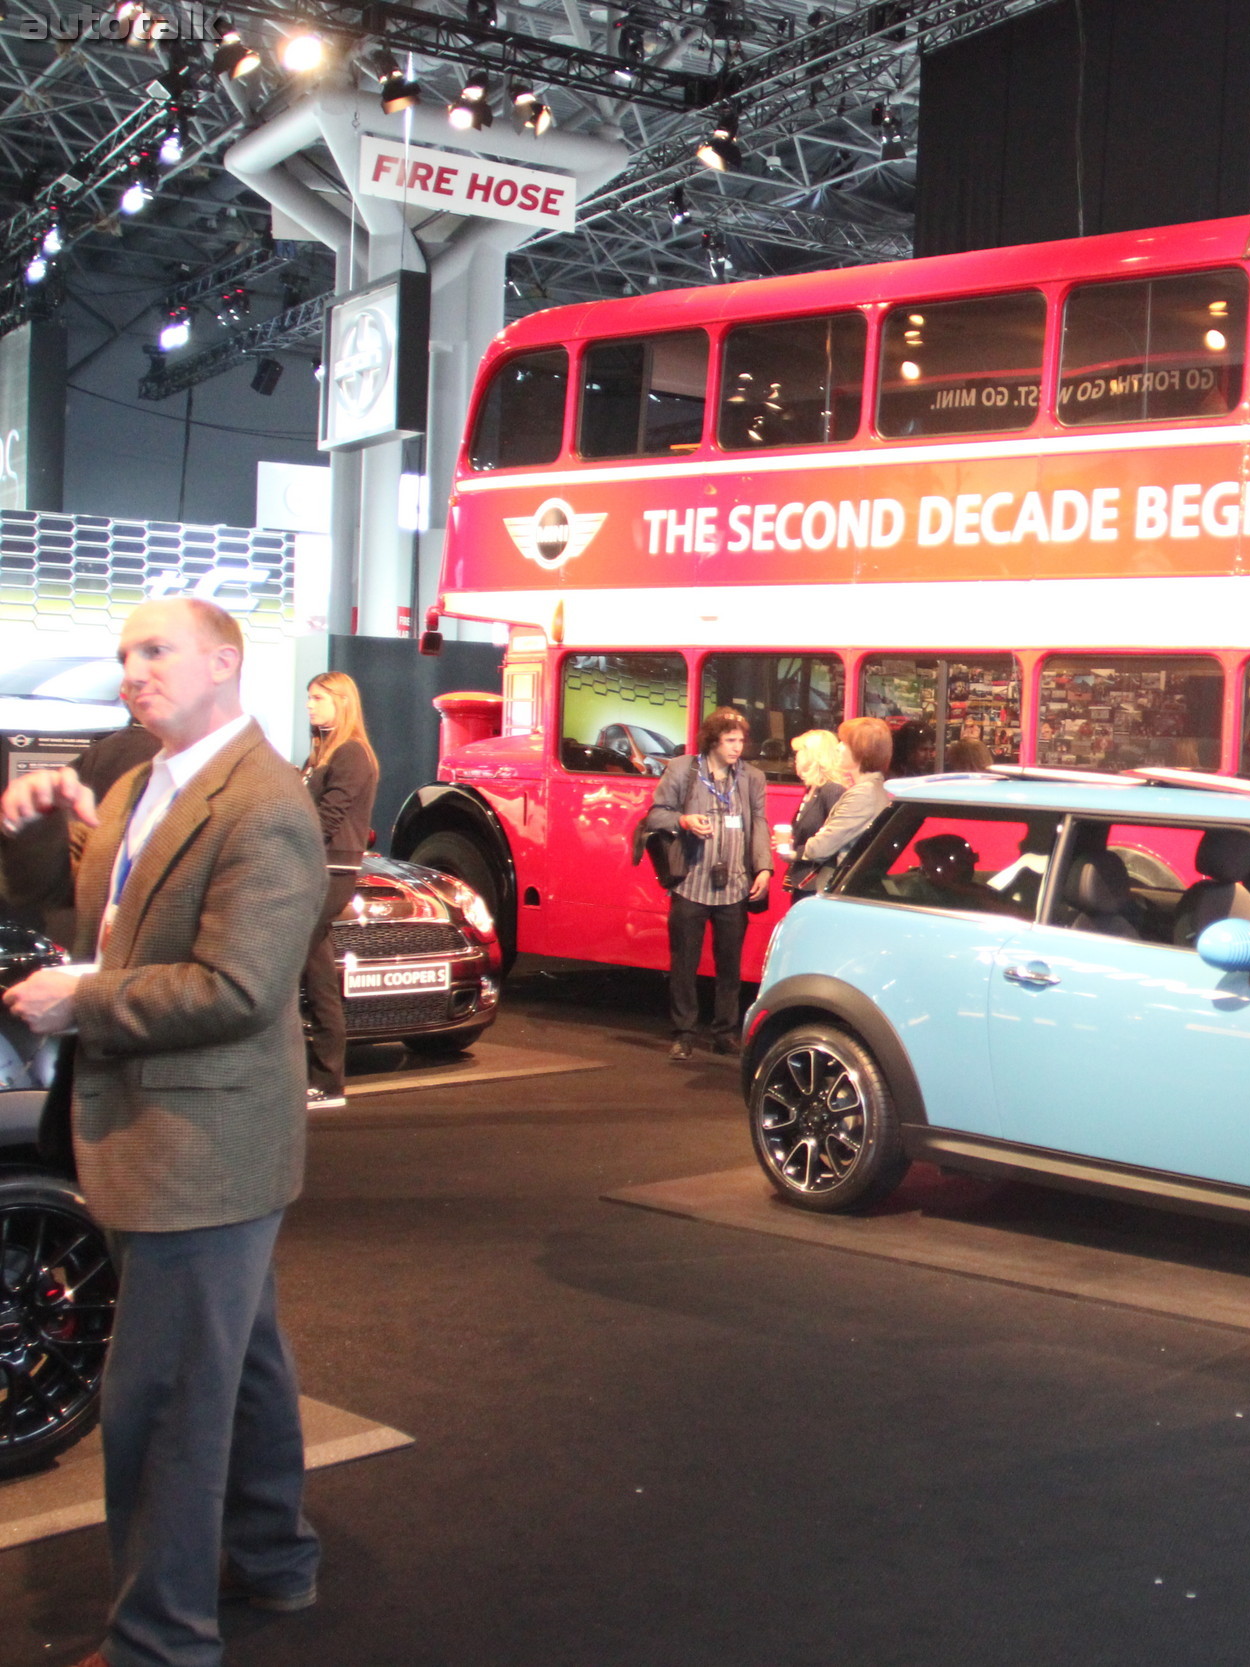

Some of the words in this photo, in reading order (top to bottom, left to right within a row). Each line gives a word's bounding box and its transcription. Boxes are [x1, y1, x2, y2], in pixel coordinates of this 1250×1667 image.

[372, 154, 458, 196] FIRE
[466, 173, 564, 216] HOSE
[643, 507, 718, 554] THE
[727, 498, 904, 552] SECOND
[917, 488, 1121, 547] DECADE
[349, 973, 381, 988] MINI
[384, 970, 435, 986] COOPER
[437, 969, 446, 982] S
